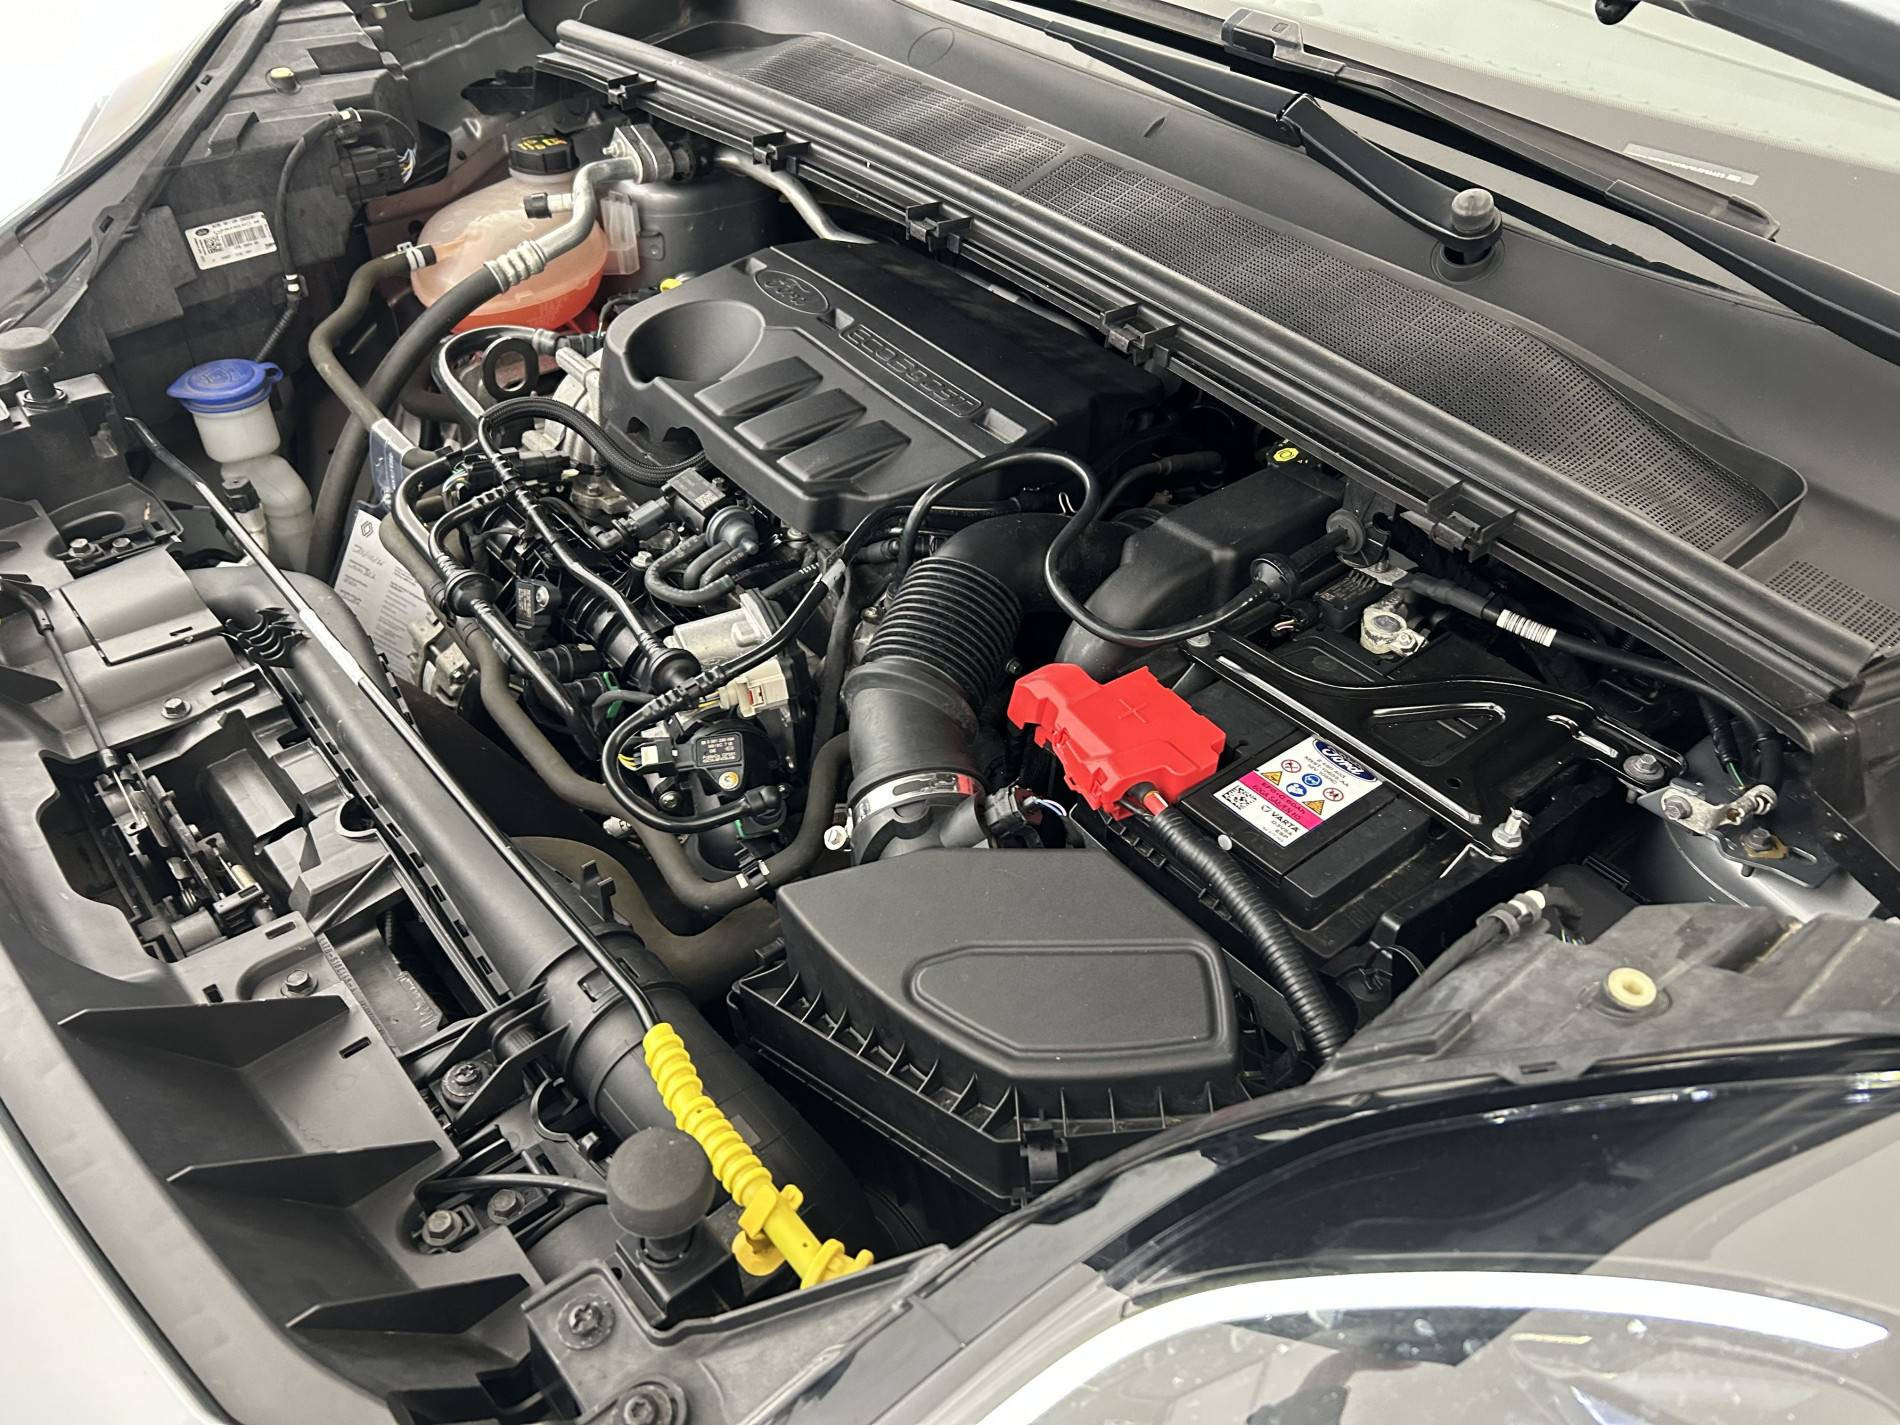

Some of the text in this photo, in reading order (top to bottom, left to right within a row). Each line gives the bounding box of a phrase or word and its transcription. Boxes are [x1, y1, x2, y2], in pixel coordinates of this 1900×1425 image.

[763, 277, 812, 305] Ford
[847, 327, 975, 411] ECOBOOST
[1321, 748, 1365, 775] Ford
[1271, 811, 1300, 833] VARTA
